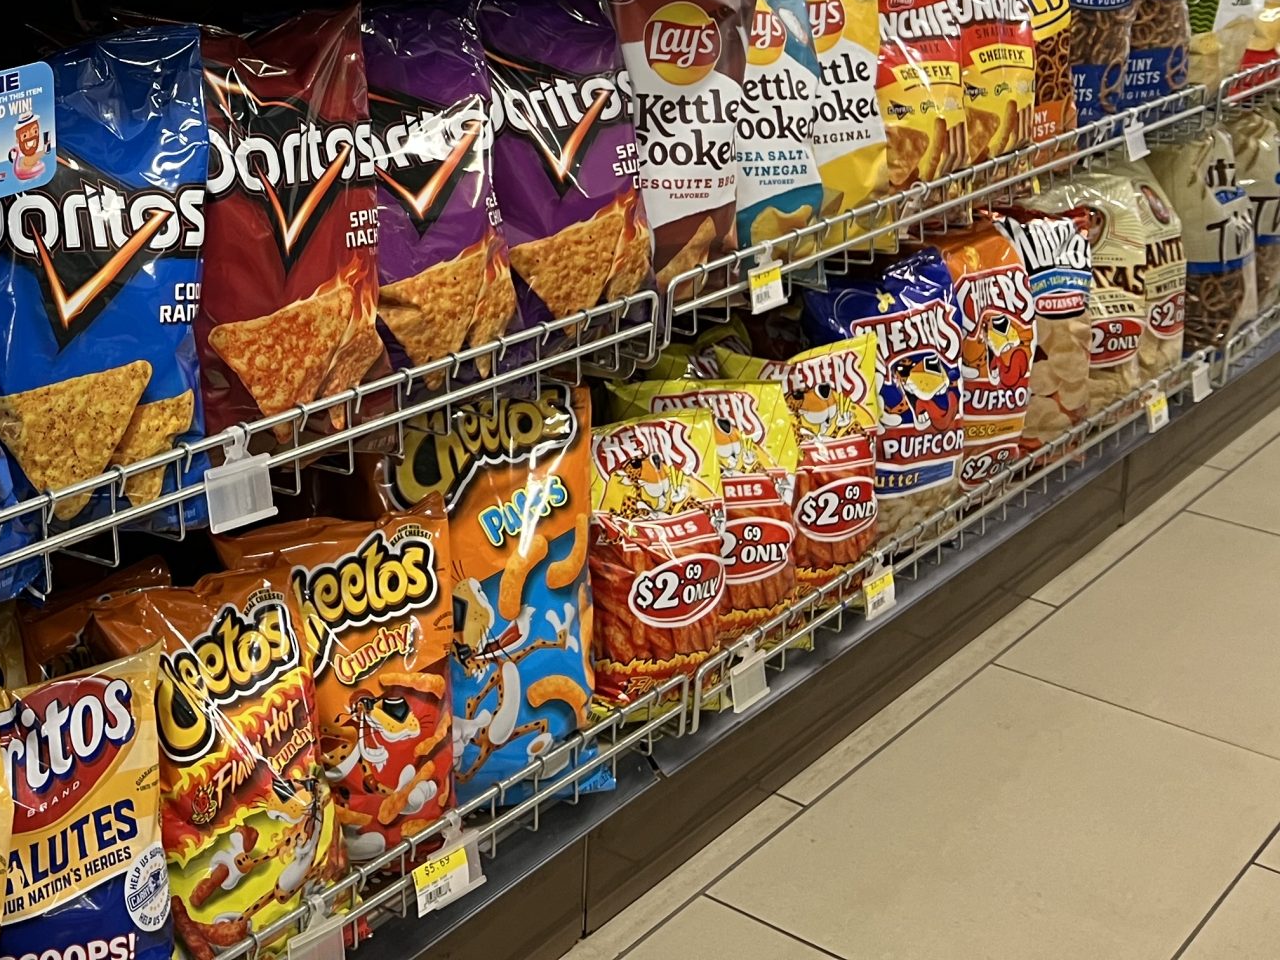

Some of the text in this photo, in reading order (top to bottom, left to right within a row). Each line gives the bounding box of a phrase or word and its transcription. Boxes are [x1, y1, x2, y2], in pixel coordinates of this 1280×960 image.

[649, 21, 716, 68] Lay's
[1008, 48, 1024, 60] FIX
[933, 66, 952, 77] FIX
[9, 92, 25, 103] THIS
[25, 87, 43, 99] ITEM
[9, 98, 33, 116] WIN!
[636, 89, 739, 138] Kettle
[736, 150, 803, 162] SEA SALT
[743, 165, 808, 177] VINEGAR
[760, 178, 795, 186] FLAVORED
[669, 192, 710, 200] FLAVORED
[1106, 303, 1135, 314] CORN
[1108, 335, 1140, 351] ONLY
[644, 520, 698, 540] FRIES
[741, 543, 789, 563] ONLY
[683, 577, 719, 603] ONLY
[334, 621, 412, 685] Crunchy
[264, 698, 300, 744] Hot
[26, 780, 81, 818] BRAND
[28, 845, 132, 907] NATION'S HEROES
